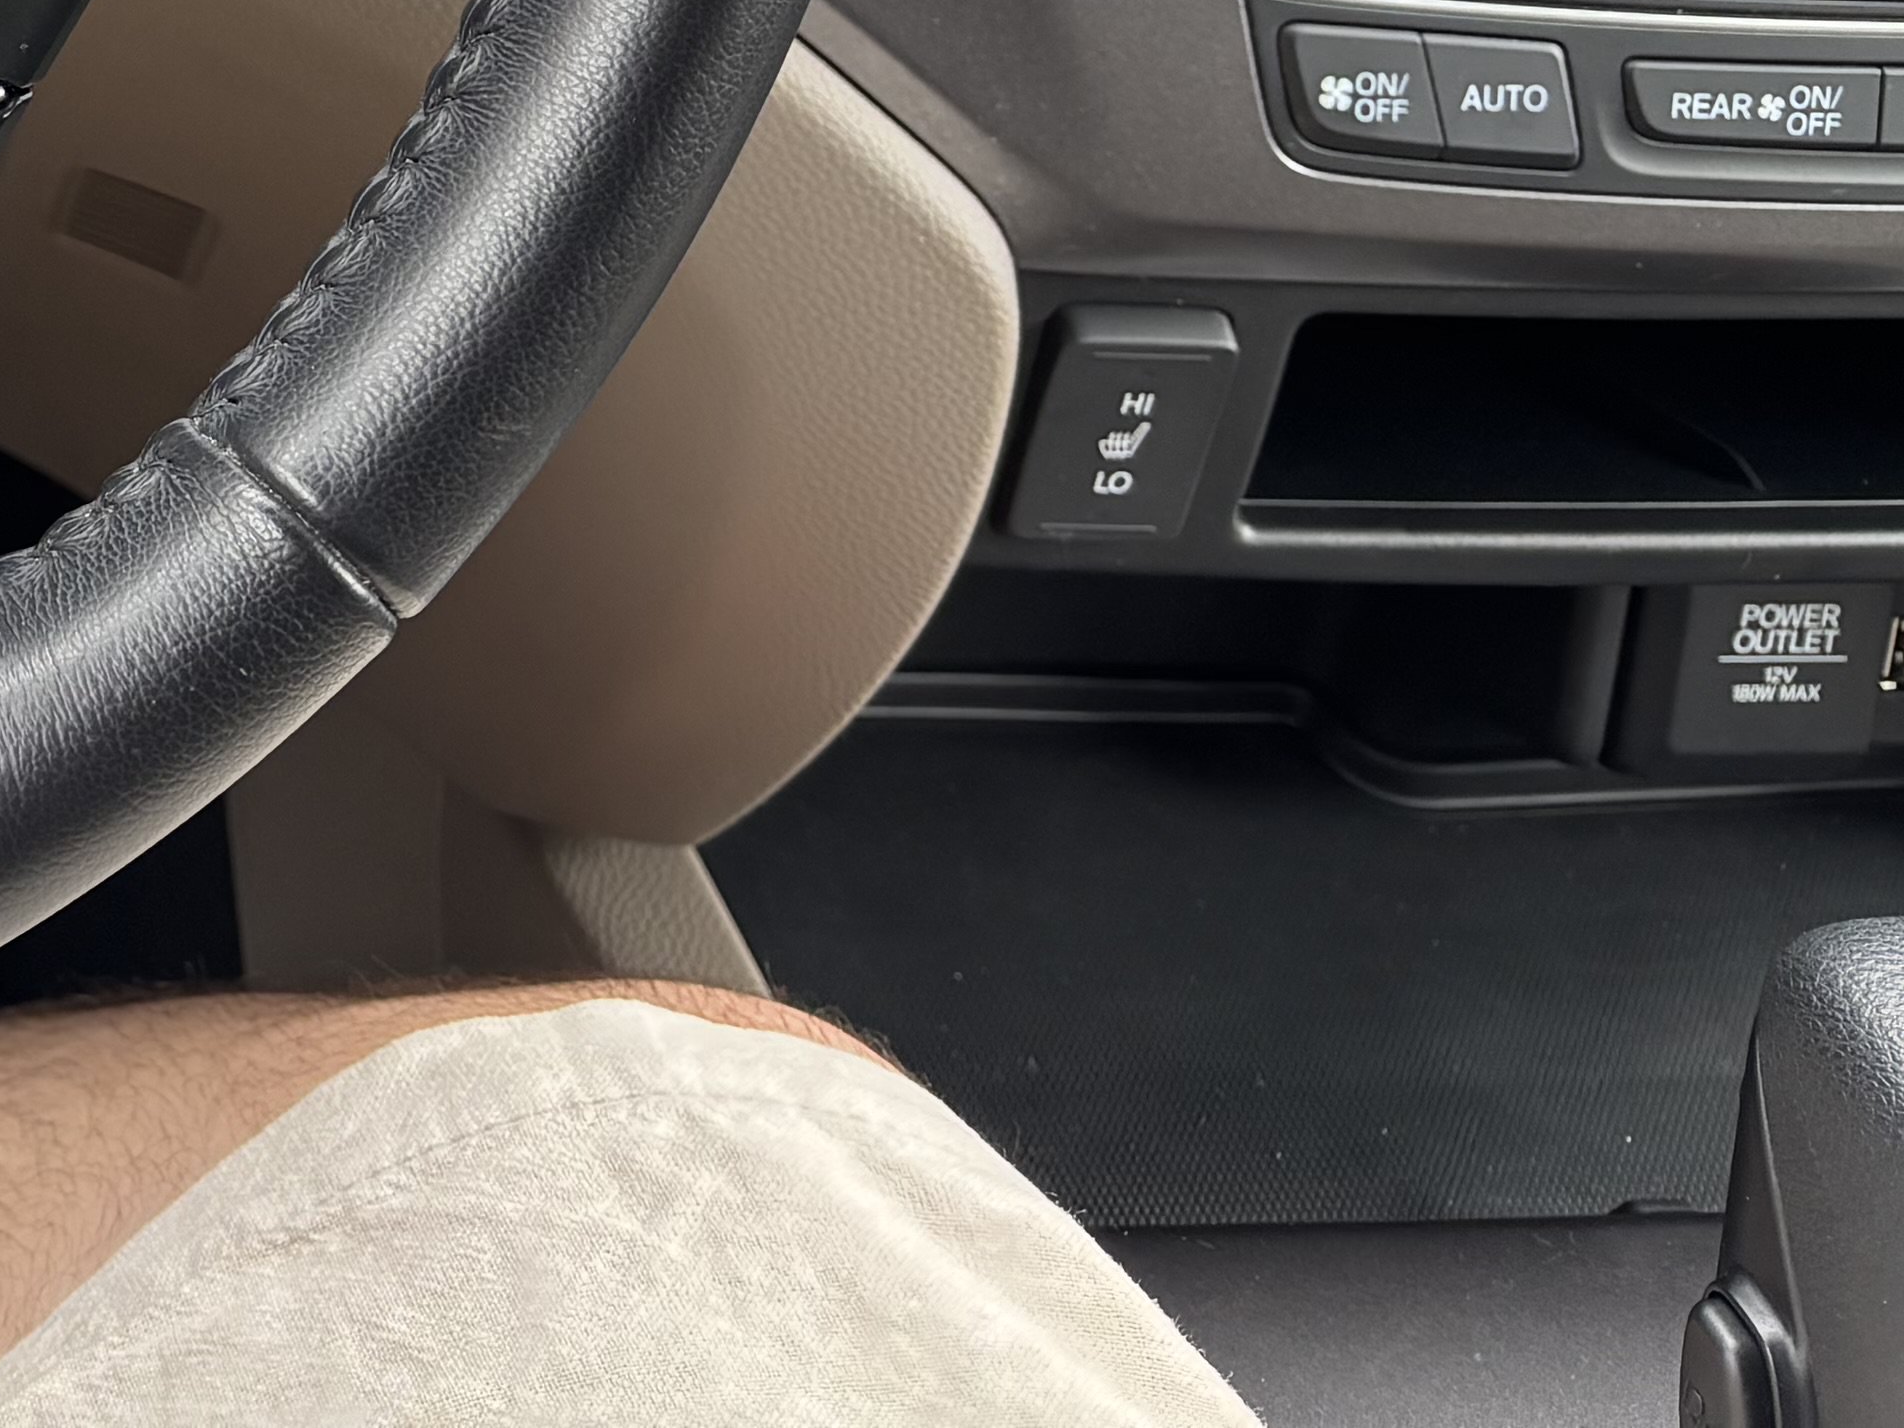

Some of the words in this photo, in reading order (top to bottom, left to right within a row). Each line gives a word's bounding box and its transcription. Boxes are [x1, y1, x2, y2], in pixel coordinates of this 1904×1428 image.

[1354, 71, 1409, 96] ON/
[1353, 97, 1410, 123] OFF
[1459, 84, 1549, 114] AUTO
[1670, 92, 1753, 121] REAR
[1788, 84, 1845, 111] ON/
[1785, 110, 1843, 137] OFF
[1119, 391, 1156, 417] HI
[1092, 471, 1134, 497] LO
[1740, 603, 1842, 629] POWER
[1732, 628, 1840, 655] OUTLET
[1778, 682, 1822, 703] MAX
